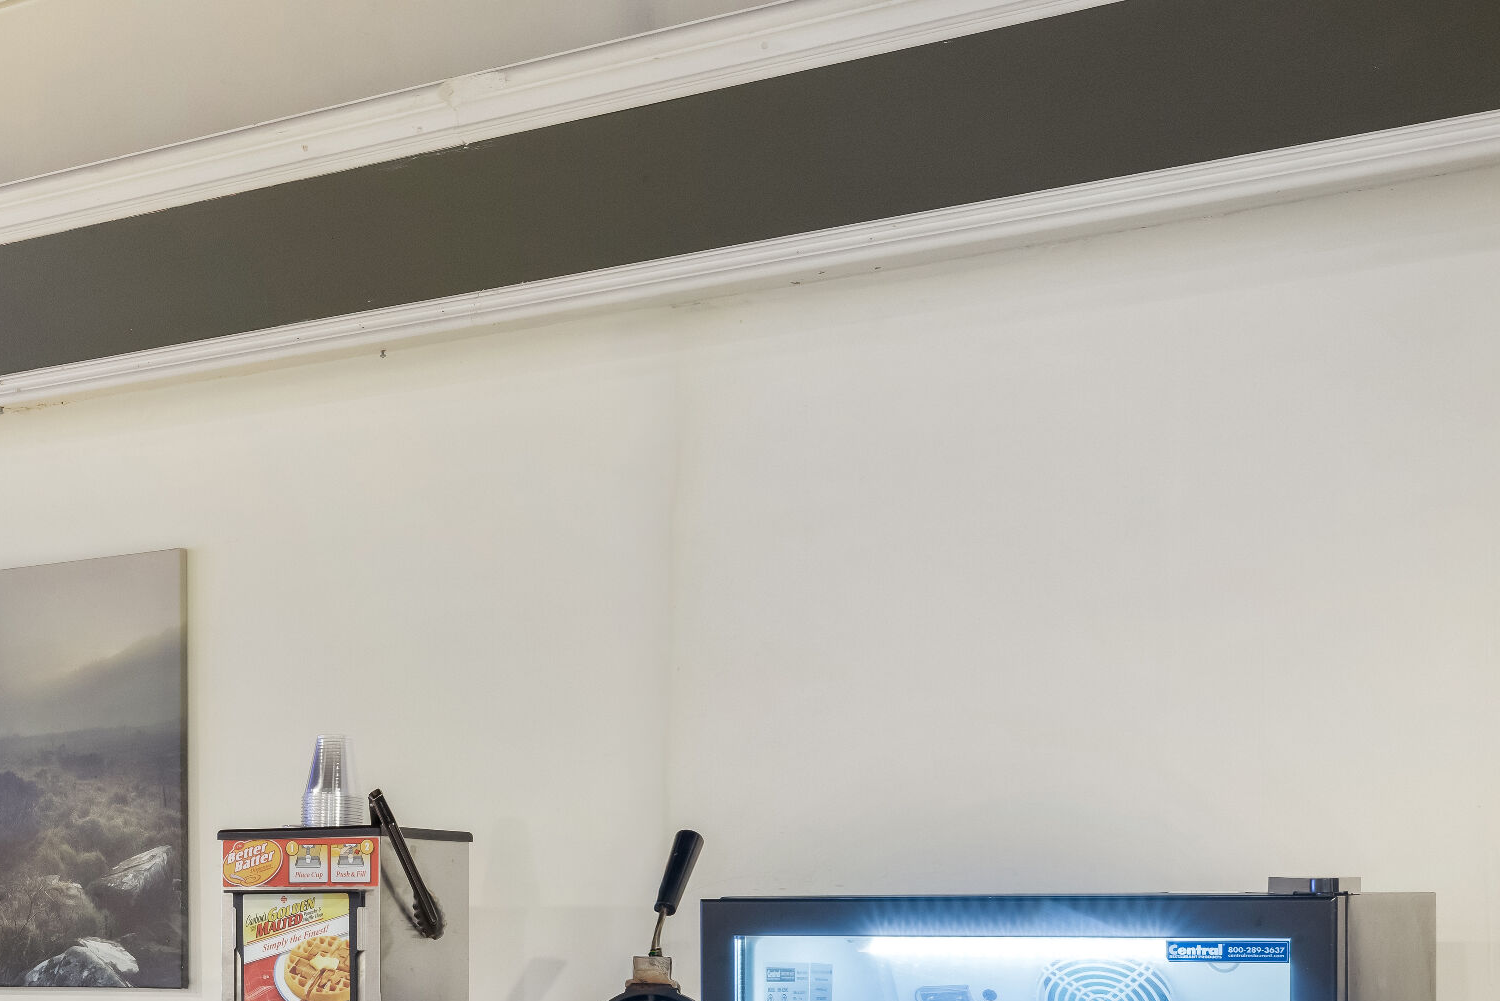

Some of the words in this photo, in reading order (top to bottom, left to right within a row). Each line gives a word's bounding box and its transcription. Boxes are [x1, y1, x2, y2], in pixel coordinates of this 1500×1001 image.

[227, 842, 268, 864] Better
[234, 850, 275, 873] Batter
[267, 897, 315, 922] GOLDEN
[255, 913, 303, 938] MALTED
[263, 938, 289, 952] Simply
[289, 935, 302, 944] the
[304, 924, 329, 940] Finest!
[1168, 943, 1223, 956] Central
[1227, 946, 1285, 954] 800-289-3637
